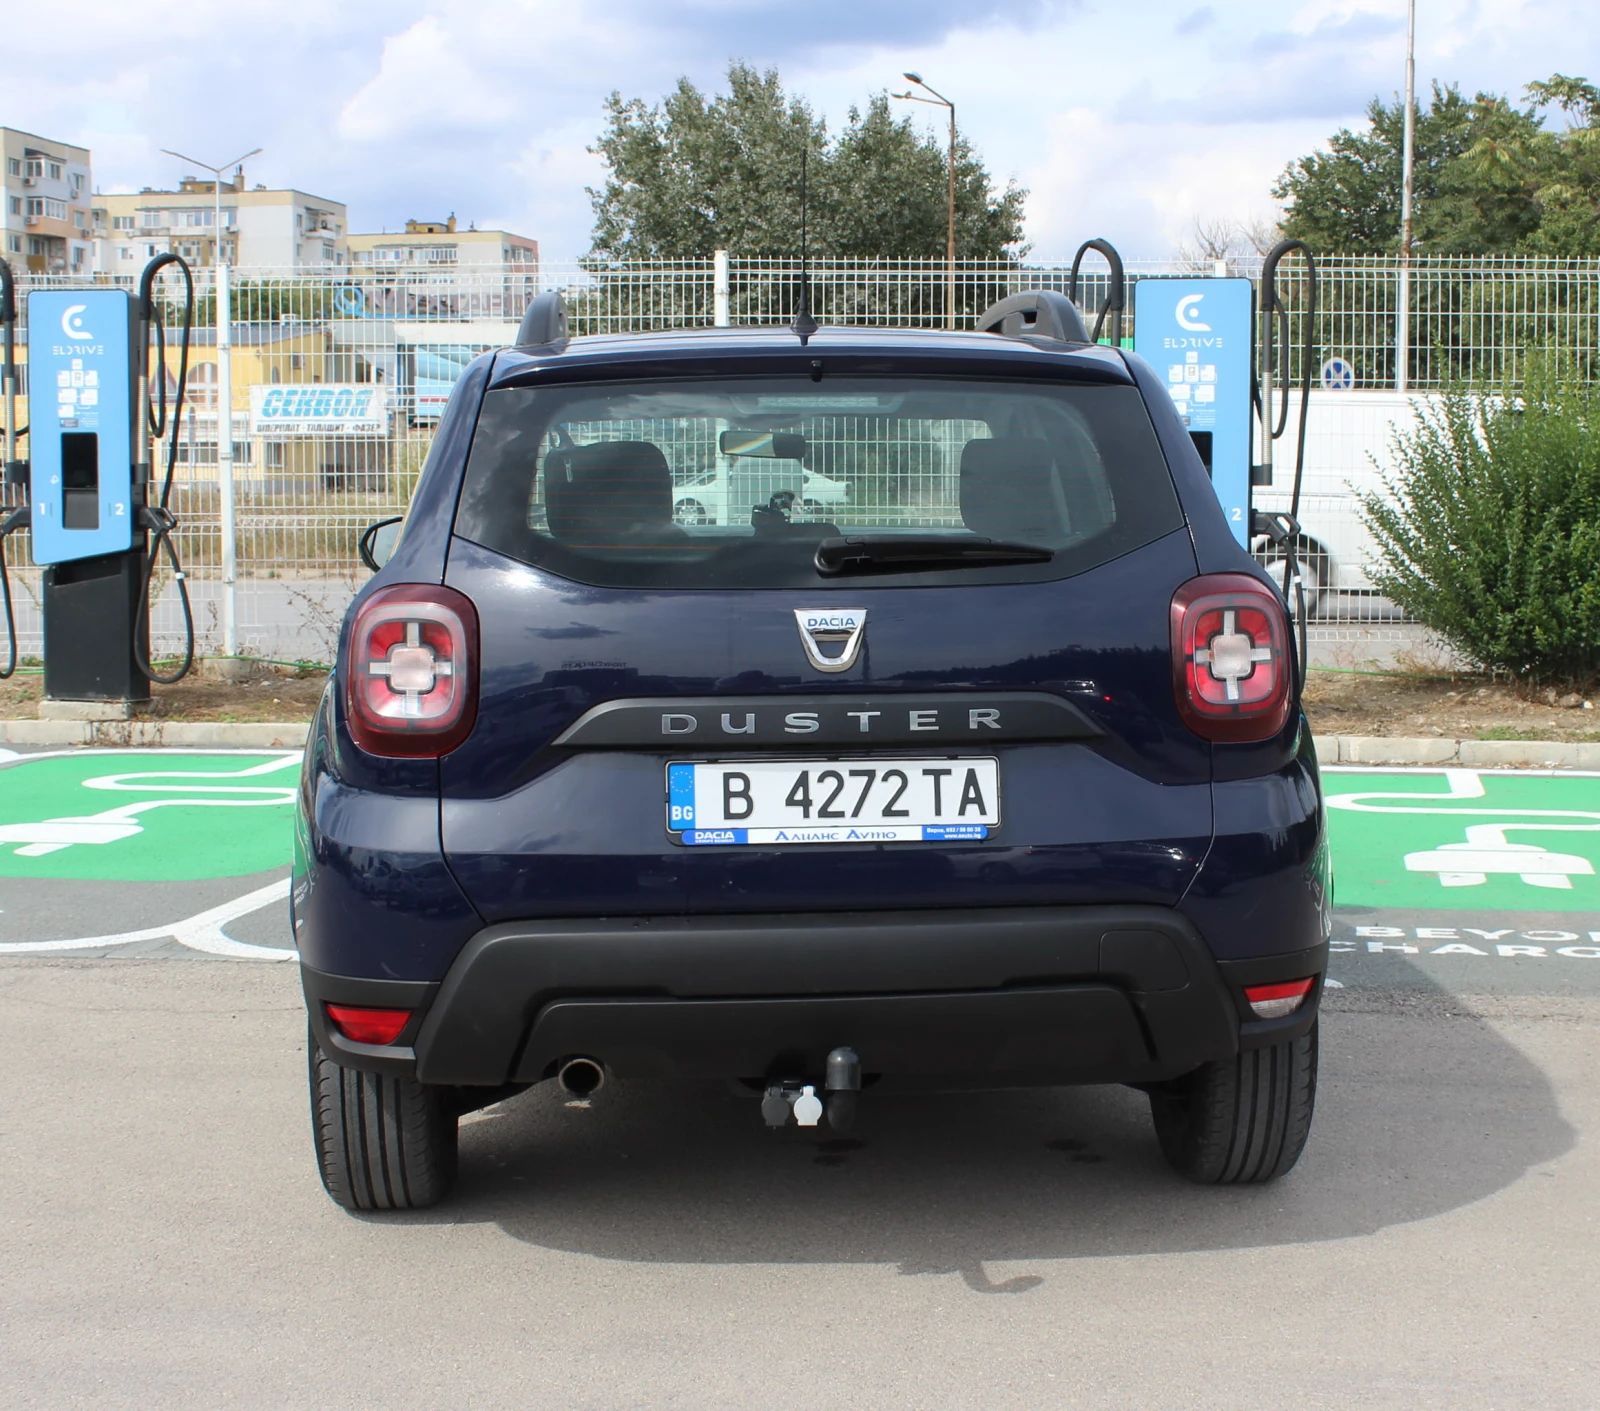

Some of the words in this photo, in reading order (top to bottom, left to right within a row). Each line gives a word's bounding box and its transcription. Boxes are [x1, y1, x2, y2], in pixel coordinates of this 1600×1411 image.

[1163, 337, 1224, 349] ELDRIVE
[52, 345, 105, 356] ELDRIVE
[261, 389, 374, 418] СЕКВОЯ
[38, 502, 47, 516] 1
[114, 503, 125, 516] 2
[1231, 507, 1243, 521] 2
[807, 617, 856, 627] DACIA
[661, 709, 1001, 734] DUSTER
[722, 772, 754, 820] B
[784, 769, 910, 820] 4272
[922, 767, 988, 818] TA
[671, 805, 694, 821] BG
[695, 831, 735, 839] DACIA
[1356, 925, 1600, 942] BEYO
